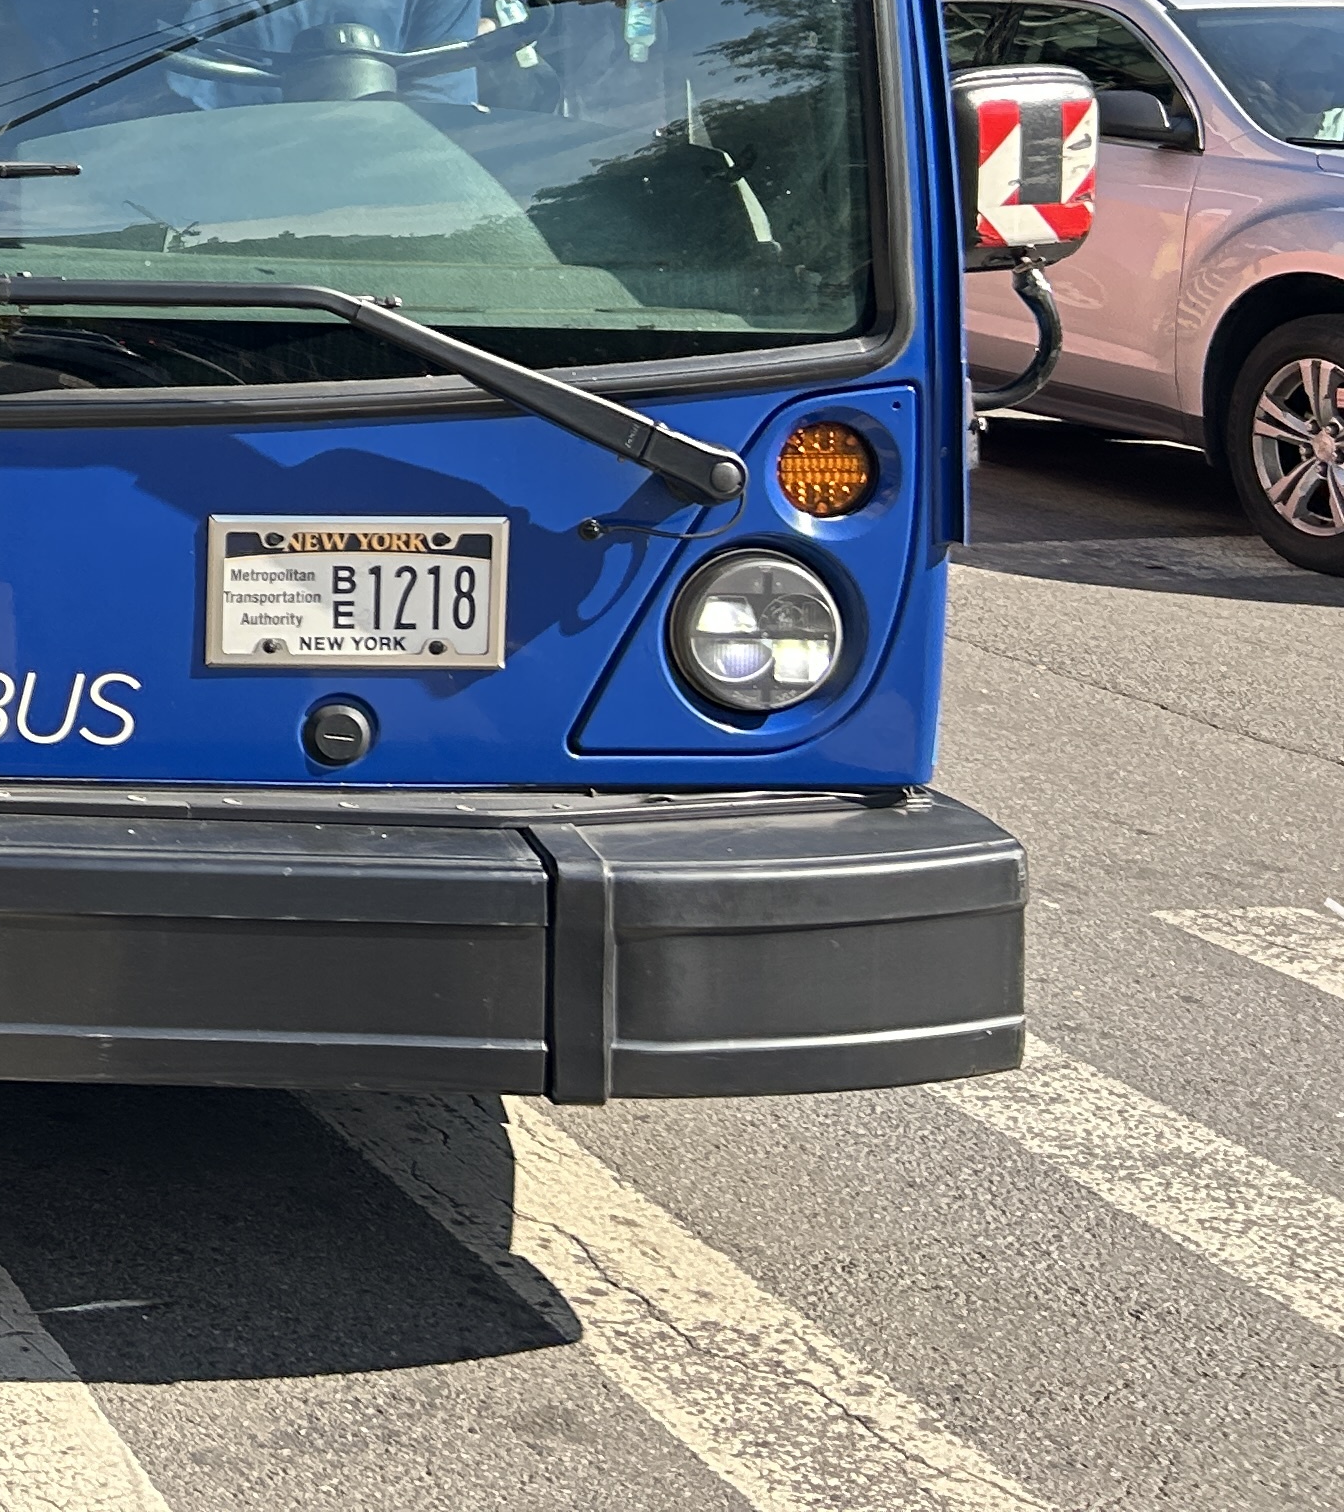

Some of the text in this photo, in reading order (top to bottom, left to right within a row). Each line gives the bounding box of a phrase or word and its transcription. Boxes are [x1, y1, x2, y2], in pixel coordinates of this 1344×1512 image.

[283, 532, 428, 552] NEW YORK
[230, 569, 316, 584] Metropolitan
[224, 590, 322, 605] Transportation
[368, 565, 476, 630] 1218
[240, 612, 304, 628] Authority
[299, 636, 407, 651] NEW YORK
